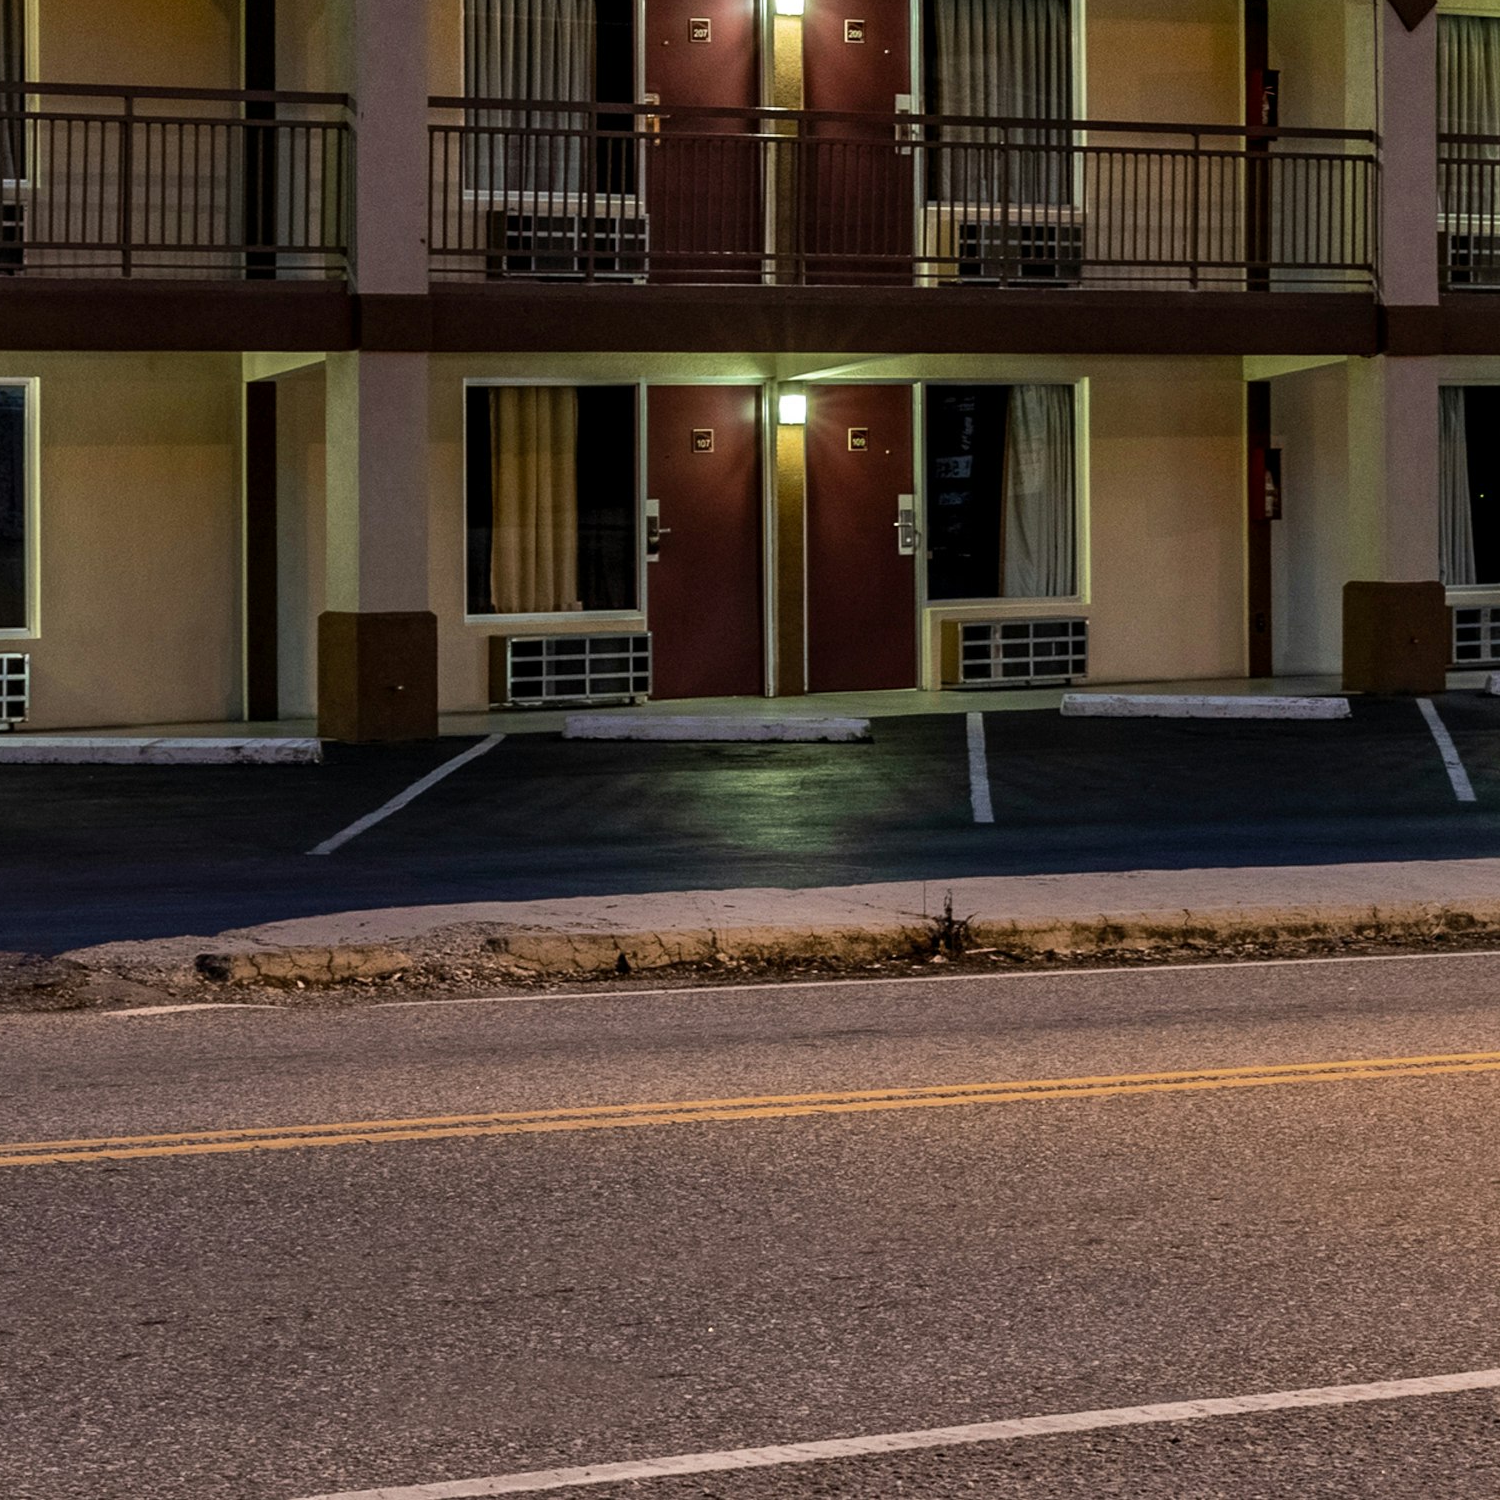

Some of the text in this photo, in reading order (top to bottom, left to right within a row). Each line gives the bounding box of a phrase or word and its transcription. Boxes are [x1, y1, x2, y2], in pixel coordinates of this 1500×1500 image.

[693, 28, 708, 38] 207
[848, 29, 863, 39] 209
[696, 439, 710, 448] 107
[852, 438, 866, 447] 109
